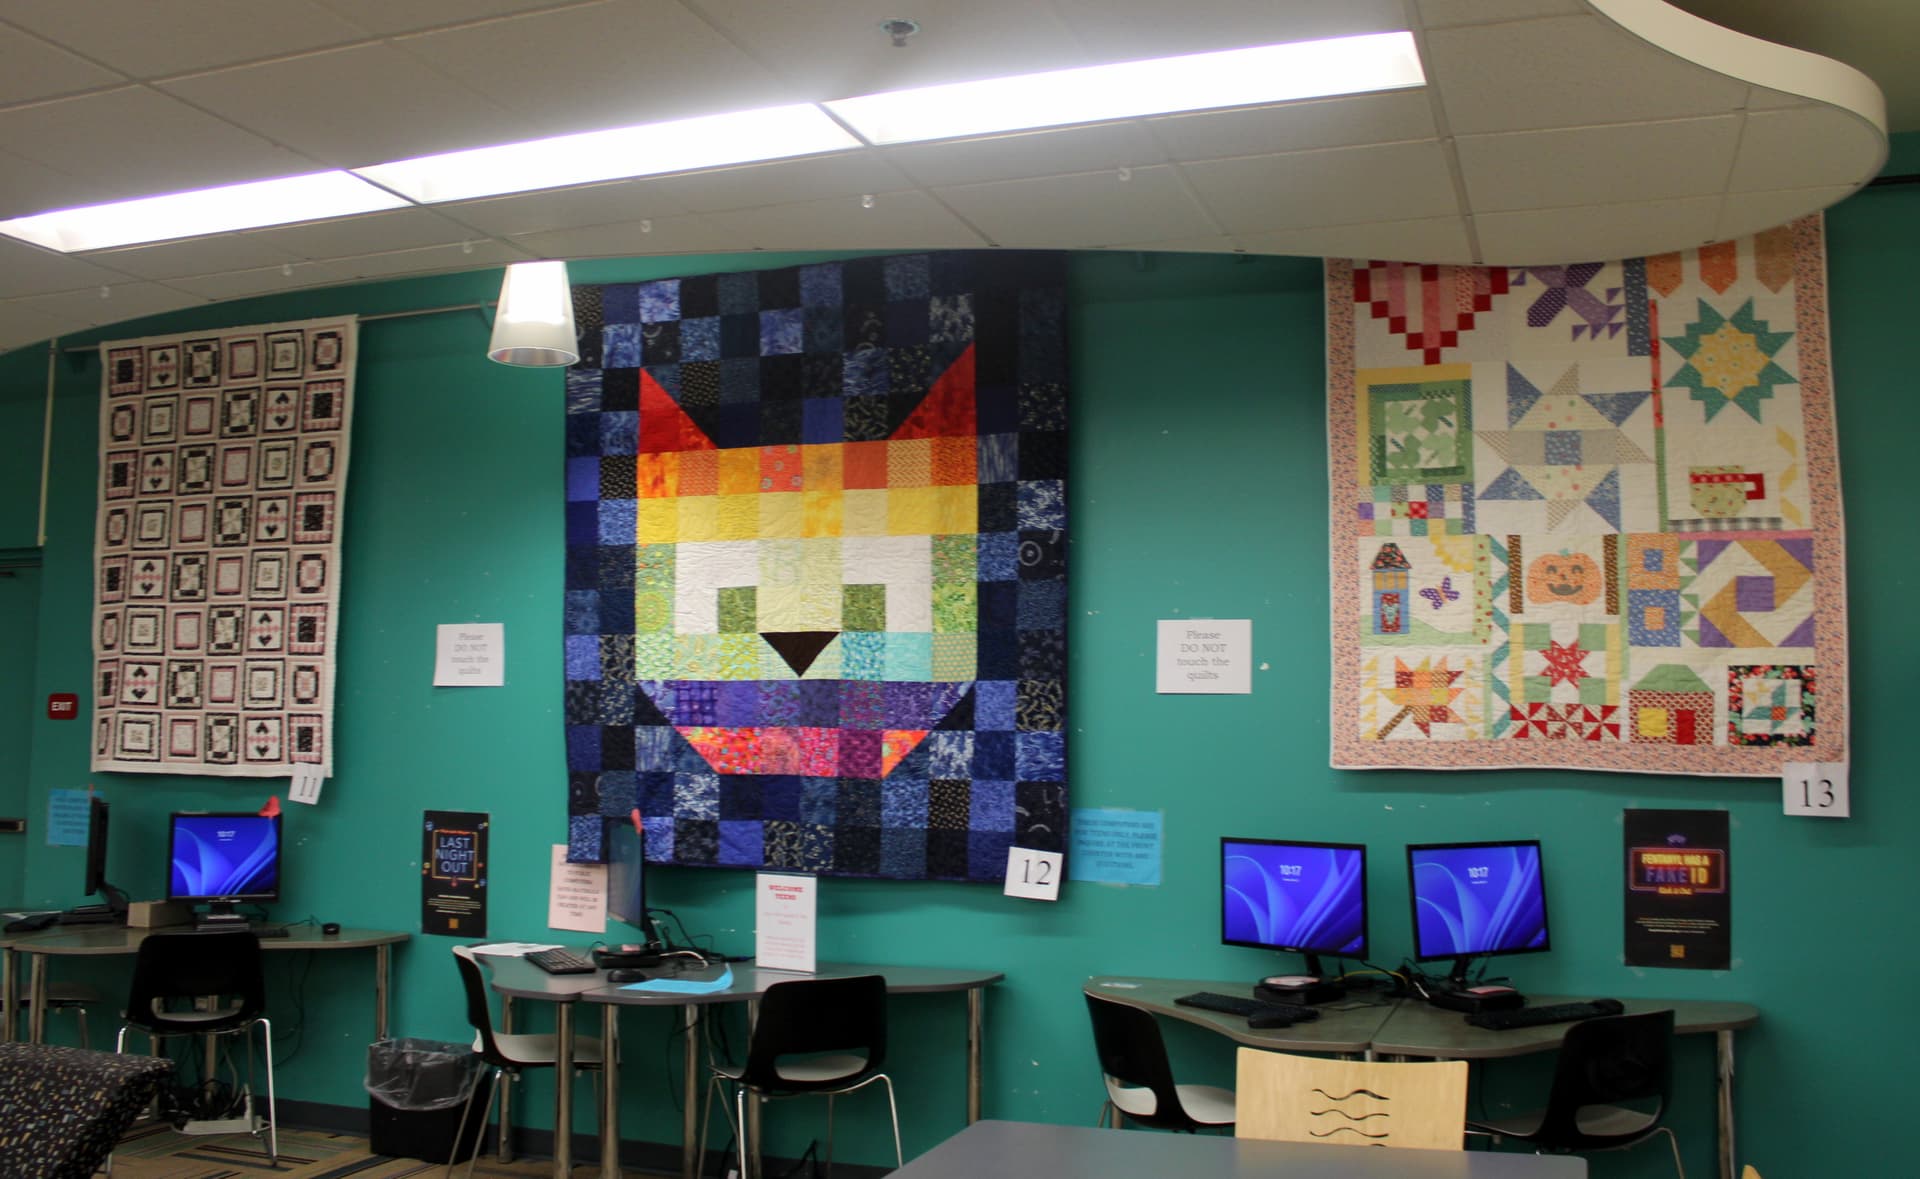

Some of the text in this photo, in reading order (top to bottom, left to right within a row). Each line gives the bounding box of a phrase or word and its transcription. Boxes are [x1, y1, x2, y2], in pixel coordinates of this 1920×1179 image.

[1186, 630, 1222, 641] Please
[1181, 643, 1228, 653] DO NOT
[1177, 656, 1231, 666] touch the
[1186, 670, 1220, 682] quilts
[51, 701, 73, 711] EXIT
[299, 776, 317, 798] 11
[1800, 779, 1834, 808] 13
[439, 837, 471, 849] LAST
[434, 848, 475, 861] NIGHT
[440, 861, 469, 873] OUT
[1021, 859, 1051, 885] 12
[1279, 865, 1302, 876] 10:17
[1468, 867, 1488, 878] 10:17
[1646, 866, 1709, 884] FAKE ID
